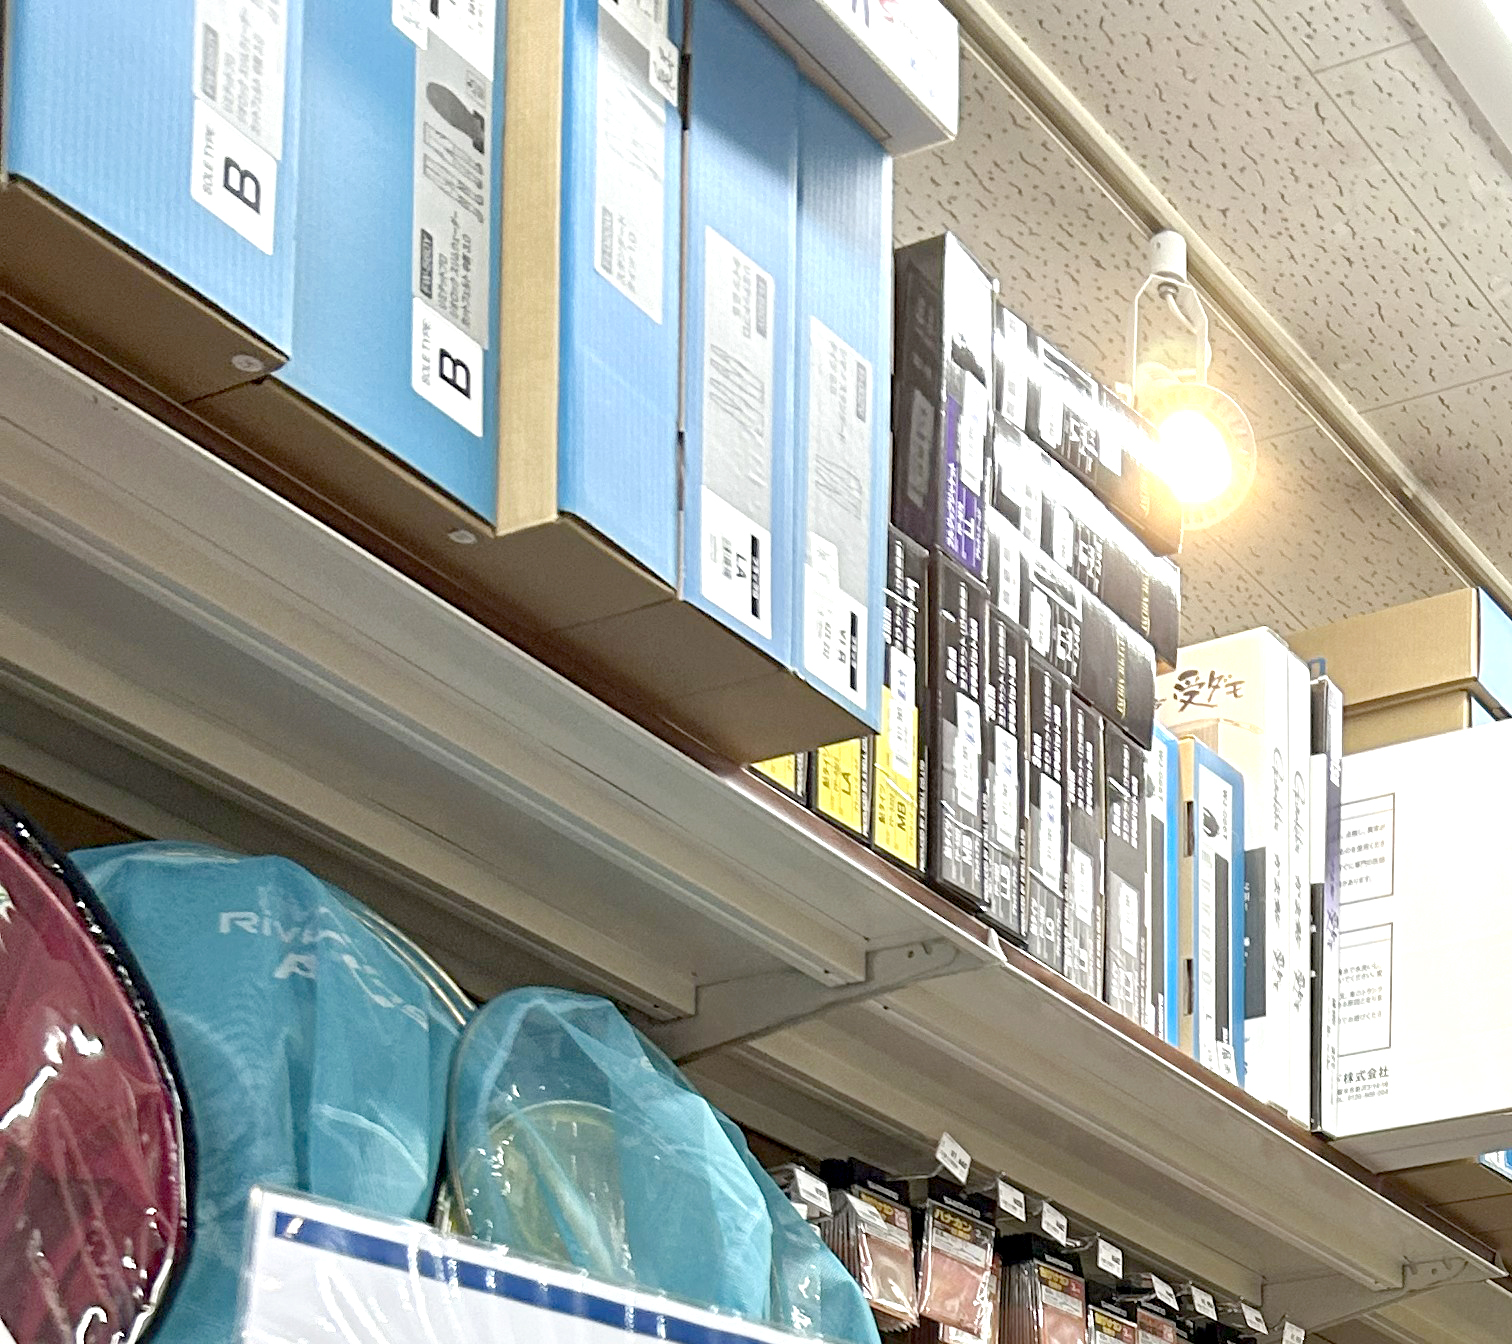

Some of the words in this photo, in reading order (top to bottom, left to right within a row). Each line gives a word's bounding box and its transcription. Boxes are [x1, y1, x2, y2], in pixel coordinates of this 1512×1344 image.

[222, 155, 262, 215] B
[437, 348, 471, 400] B
[735, 553, 748, 579] LA
[841, 771, 852, 796] LA
